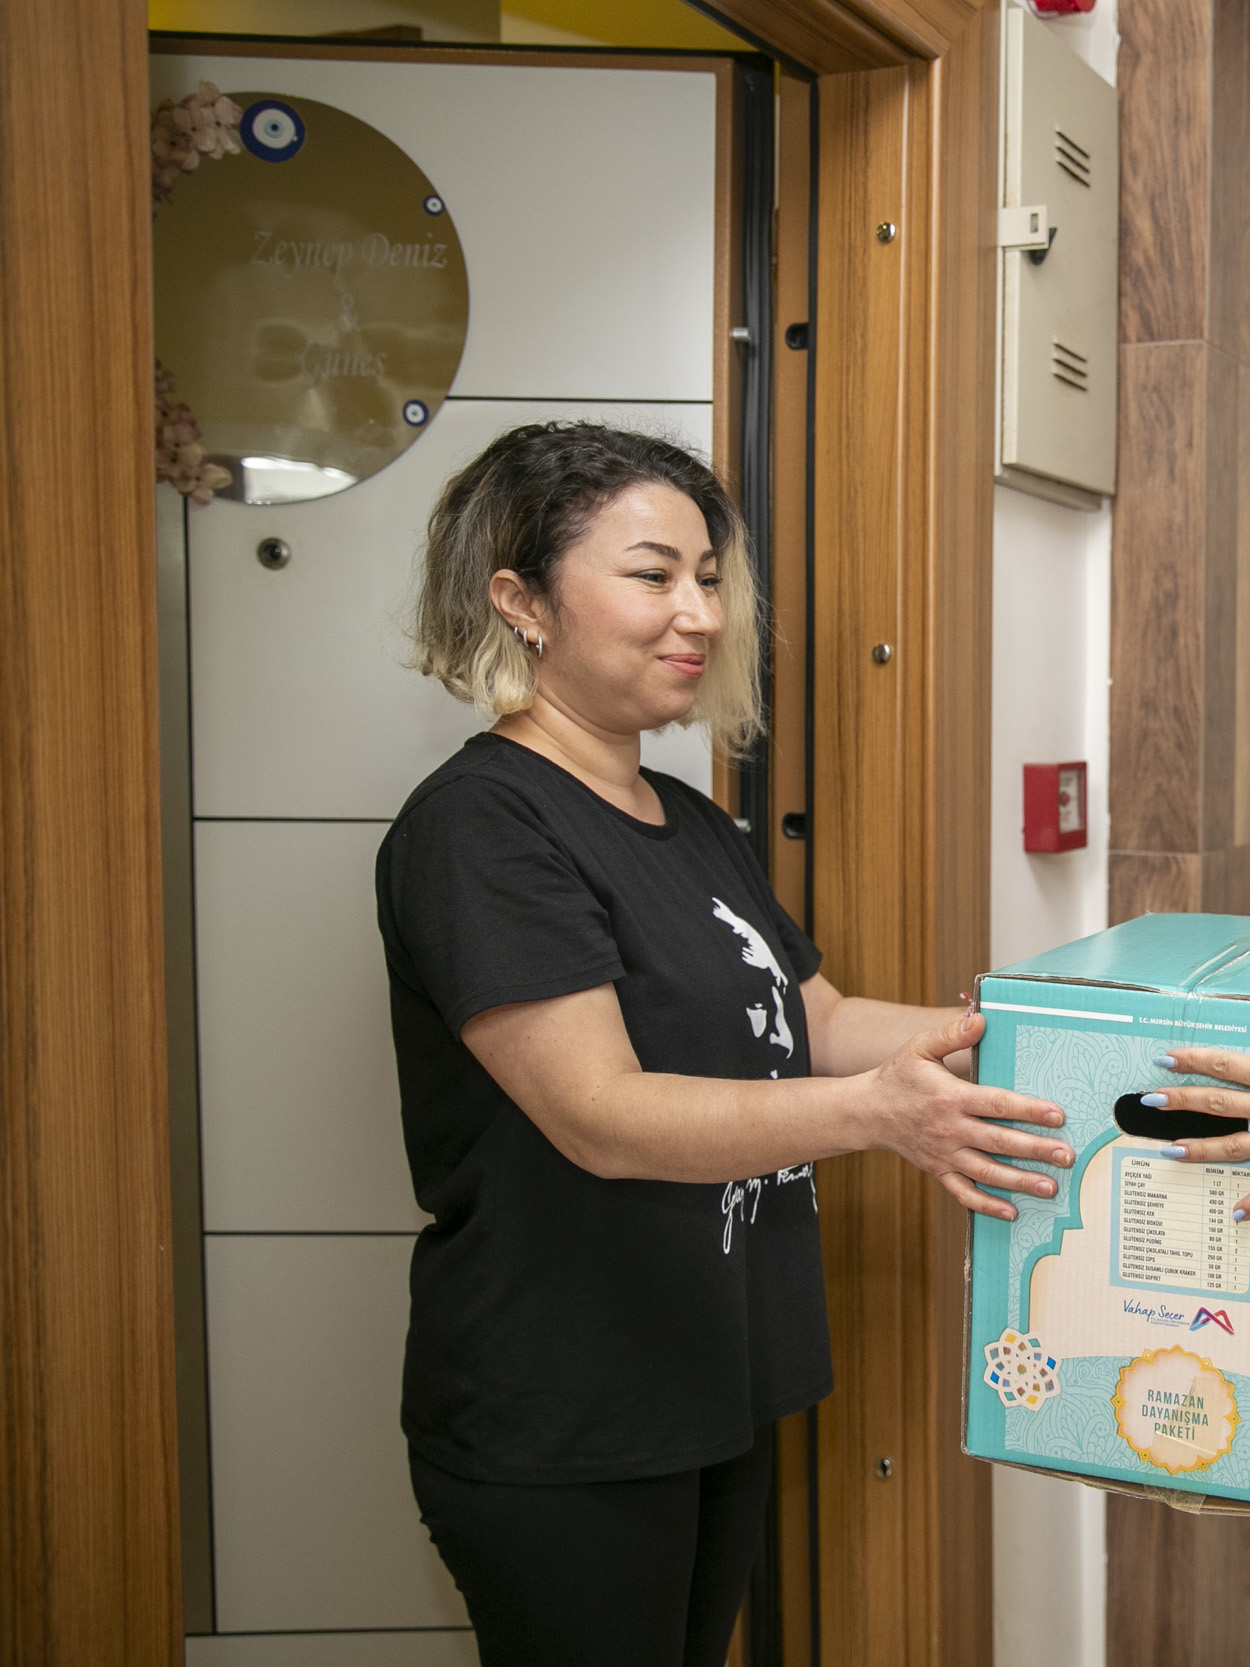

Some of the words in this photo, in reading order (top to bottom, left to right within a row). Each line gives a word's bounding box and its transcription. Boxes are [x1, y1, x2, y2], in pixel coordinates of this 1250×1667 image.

[250, 231, 352, 282] Zeynep
[363, 232, 448, 268] Deniz
[338, 293, 361, 334] &
[1150, 1018, 1173, 1026] MERSİN
[1174, 1020, 1213, 1030] BÜYÜKŞEHİR
[1214, 1024, 1247, 1032] BELEDİYESİ
[1132, 1159, 1150, 1167] ÜRÜN
[1124, 1199, 1146, 1207] GLUTENSİZ
[1124, 1208, 1146, 1216] GLUTENSİZ
[1124, 1217, 1146, 1225] GLUTENSİZ
[1124, 1226, 1145, 1234] GLUTENSİZ
[1123, 1299, 1156, 1322] Vahap
[1147, 1389, 1204, 1409] RAMAZAN
[1142, 1404, 1209, 1426] DAYANIŞMA
[1154, 1422, 1195, 1440] PAKETİ
